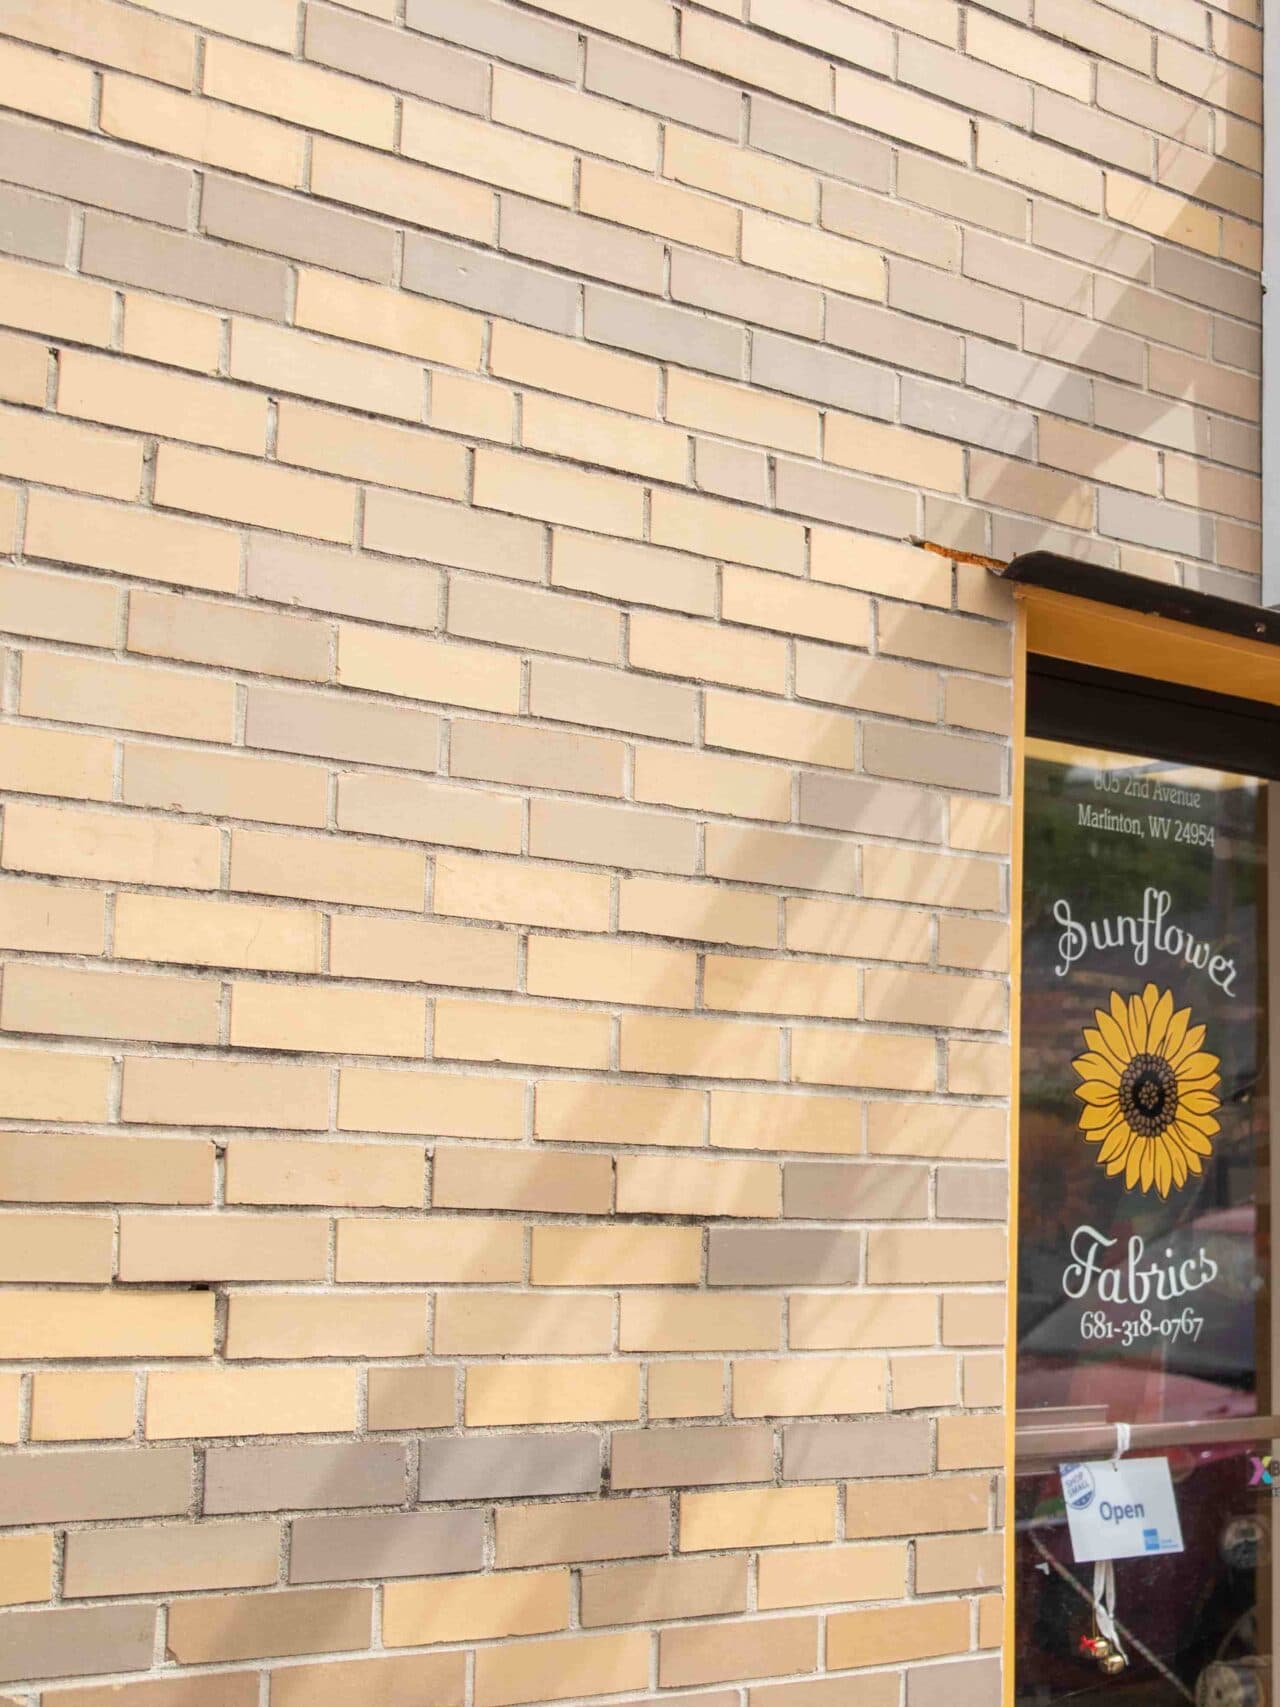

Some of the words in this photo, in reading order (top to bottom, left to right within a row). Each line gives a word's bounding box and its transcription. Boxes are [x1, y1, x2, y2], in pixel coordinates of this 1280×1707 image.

[1124, 773, 1150, 798] 2nd
[1153, 779, 1201, 809] Avenue
[1077, 803, 1145, 840] Marlinton,
[1148, 815, 1172, 840] WV
[1174, 820, 1216, 849] 24954
[1053, 886, 1237, 997] Sunflower
[1062, 1224, 1218, 1304] Fabrics
[1080, 1307, 1204, 1347] 681-318-0767
[1065, 1471, 1084, 1488] SHOP
[1067, 1480, 1091, 1499] SMALL
[1099, 1501, 1145, 1525] Open
